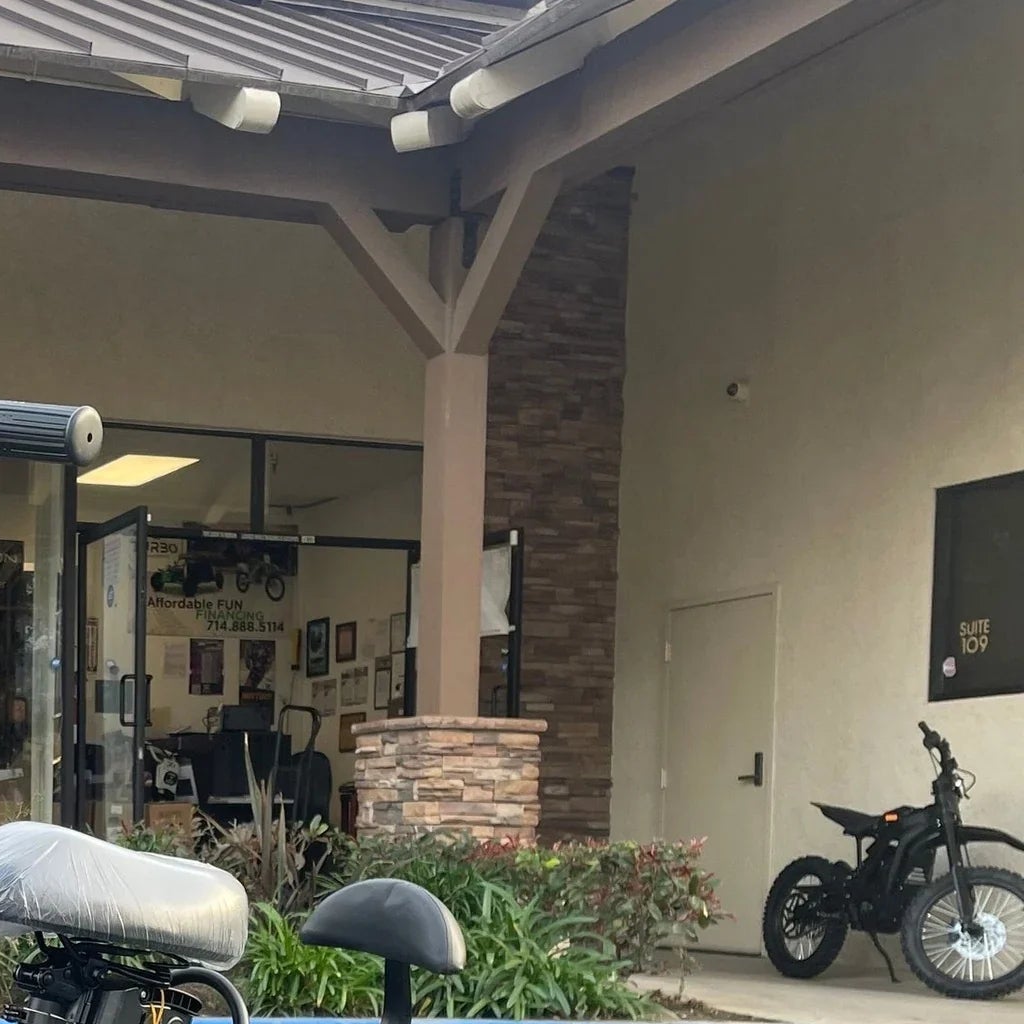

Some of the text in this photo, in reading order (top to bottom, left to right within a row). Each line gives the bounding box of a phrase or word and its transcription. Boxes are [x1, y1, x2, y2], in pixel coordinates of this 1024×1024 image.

[147, 597, 243, 611] Affordable FUN
[196, 610, 264, 622] FINANCING
[207, 620, 284, 633] 714.888.5114
[960, 618, 990, 637] SUITE
[962, 635, 989, 654] 109
